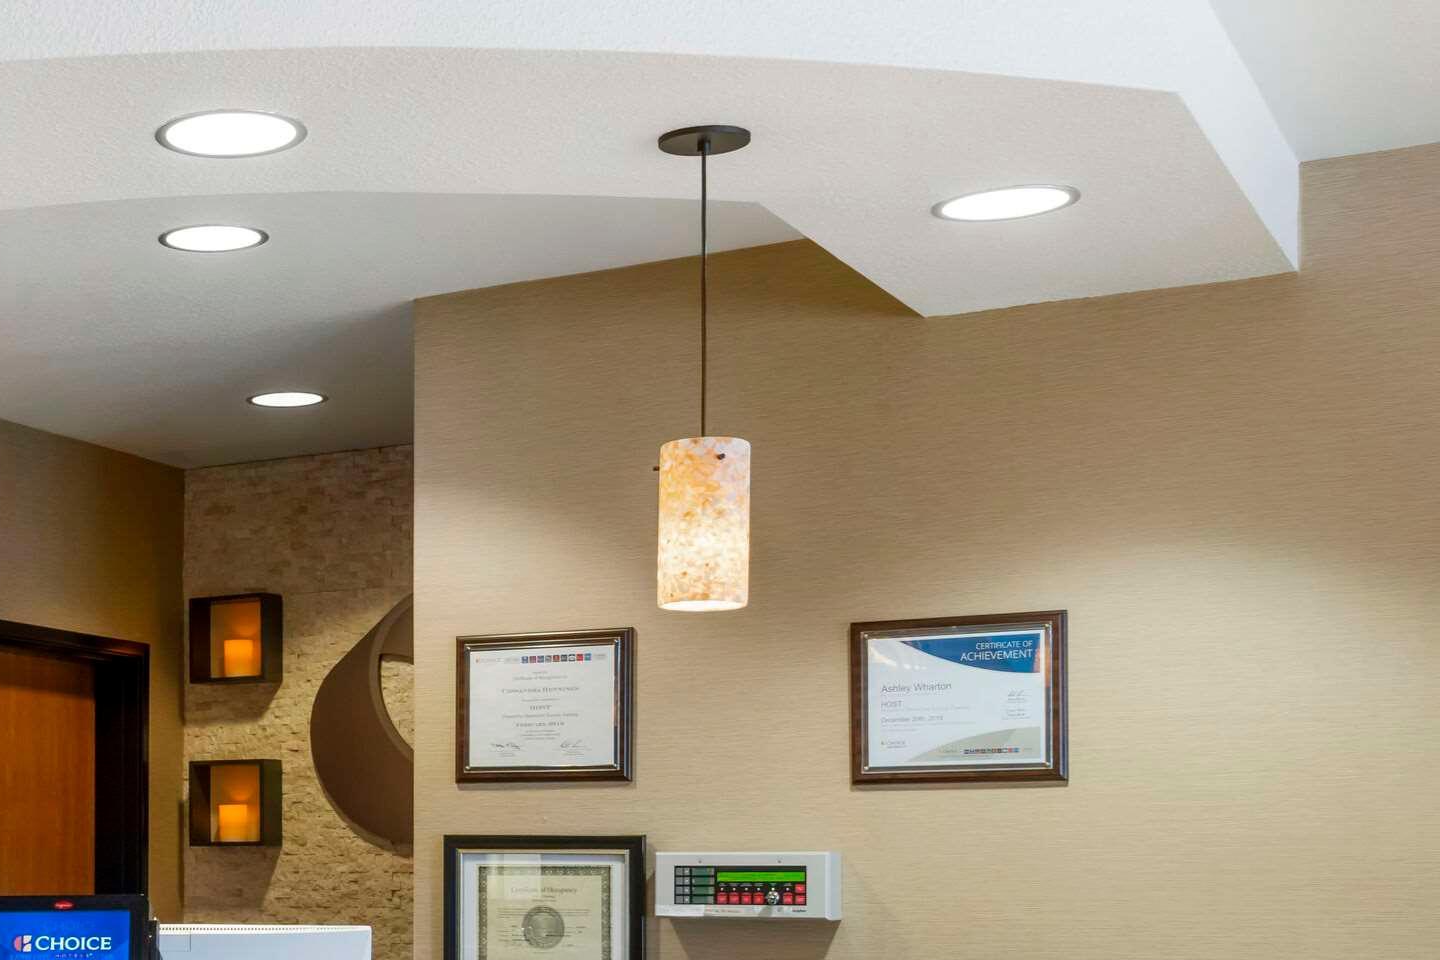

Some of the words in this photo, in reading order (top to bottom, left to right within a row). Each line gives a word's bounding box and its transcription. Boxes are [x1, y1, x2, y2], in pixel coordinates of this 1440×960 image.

[976, 641, 1021, 650] CERTIFICATE
[1022, 640, 1033, 648] OF
[960, 649, 1033, 661] ACHIEVEMENT
[881, 683, 911, 693] Ashley
[35, 935, 112, 951] CHOICE
